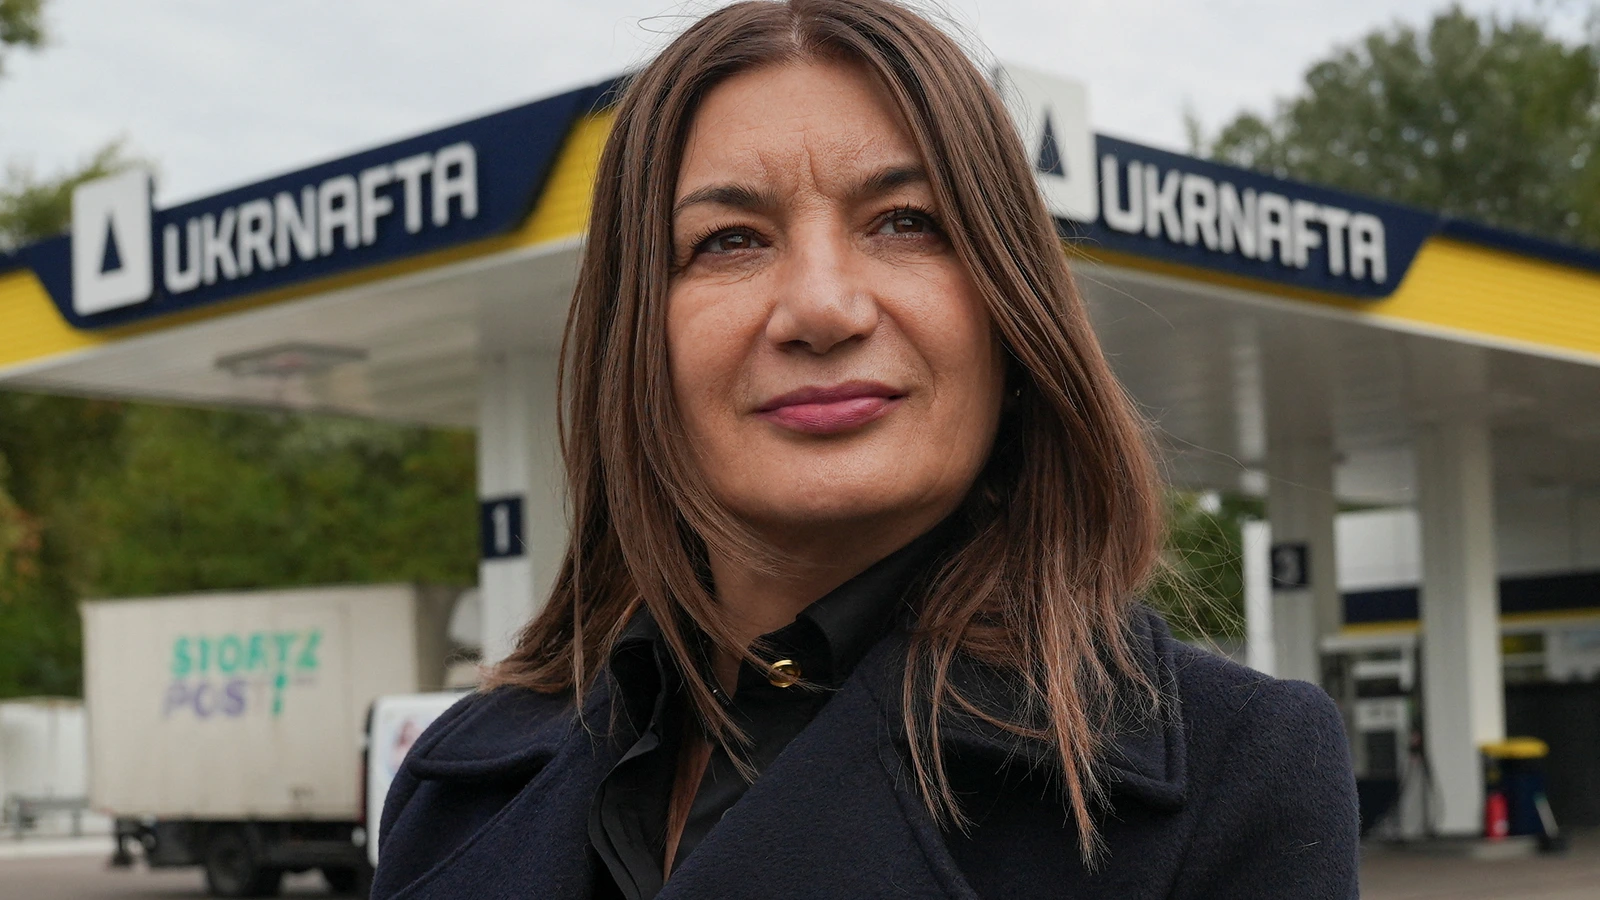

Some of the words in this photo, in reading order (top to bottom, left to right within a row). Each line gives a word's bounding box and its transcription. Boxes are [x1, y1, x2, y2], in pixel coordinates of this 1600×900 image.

[163, 141, 478, 292] UKRNAFTA
[1102, 155, 1387, 284] UKRNAFTA
[493, 504, 510, 553] 1
